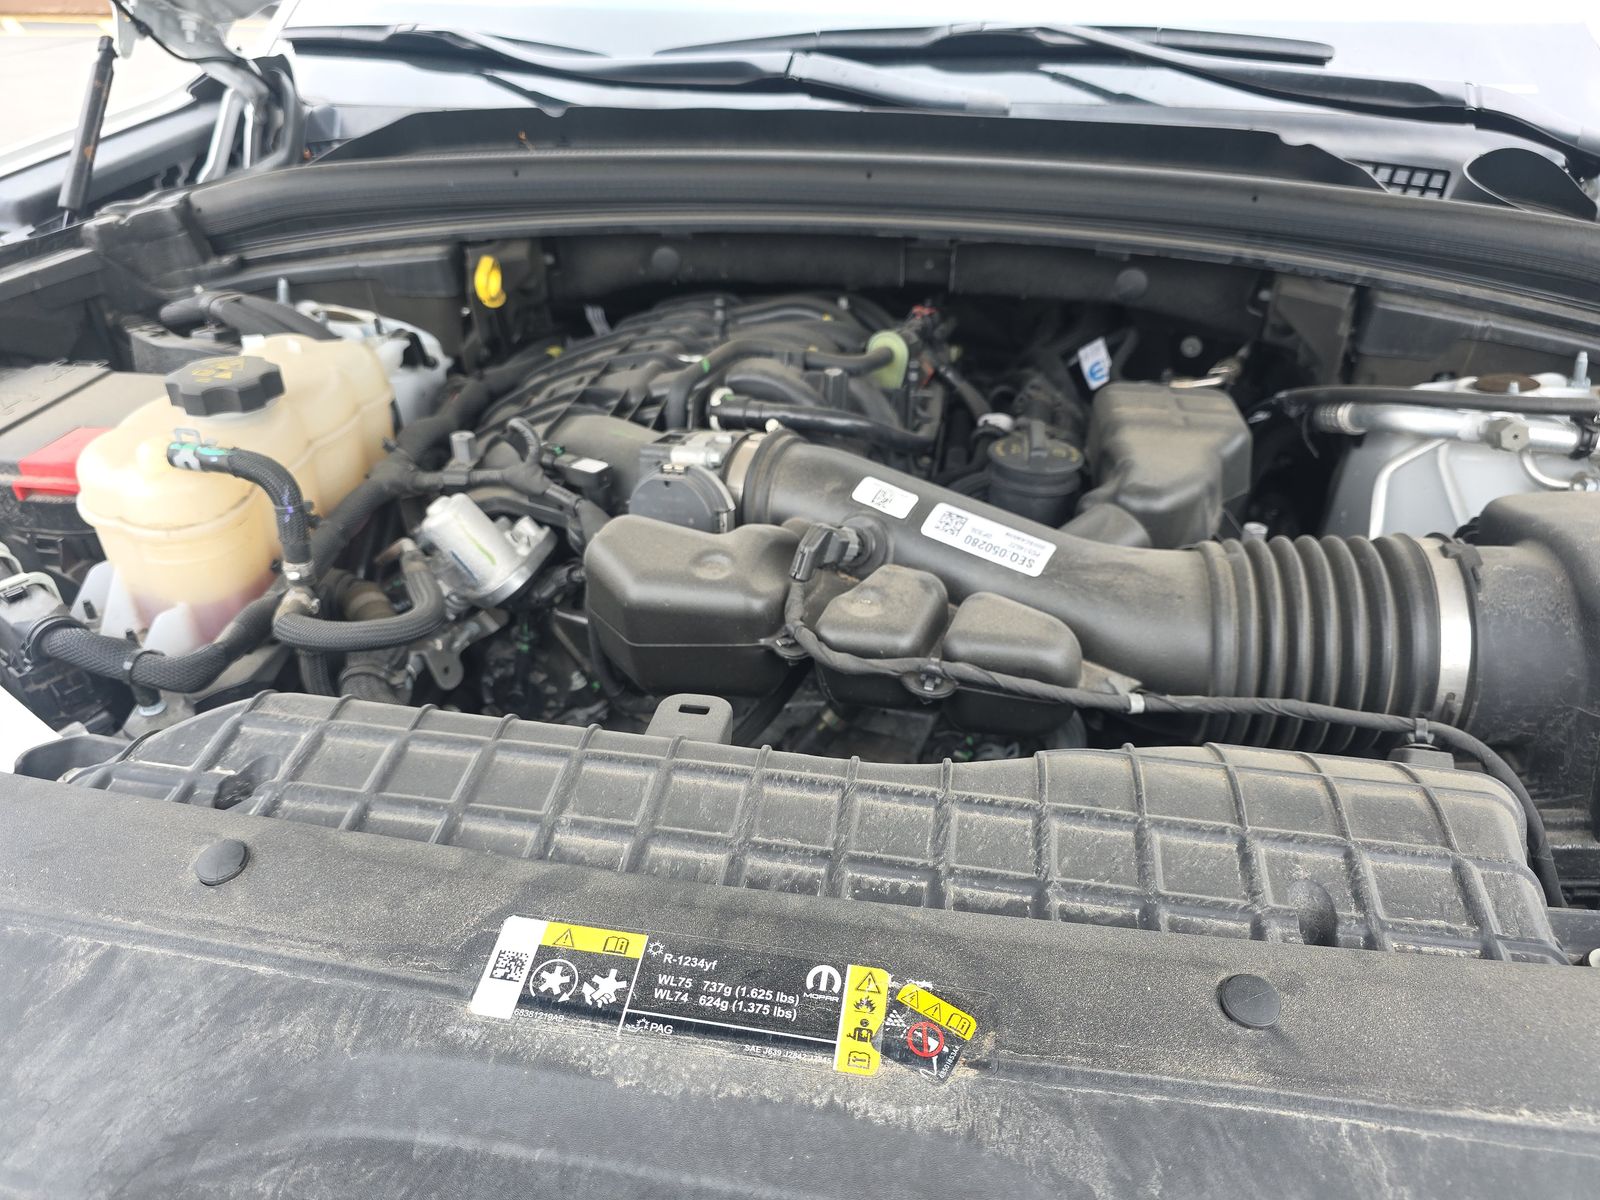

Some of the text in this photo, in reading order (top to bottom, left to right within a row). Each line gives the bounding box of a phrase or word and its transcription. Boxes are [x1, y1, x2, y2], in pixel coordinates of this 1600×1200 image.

[663, 953, 718, 971] R-1234yf
[658, 974, 800, 1006] WL75 737g (1.625 lbs)
[803, 992, 839, 1003] MOPAR
[654, 988, 797, 1021] WL74 624g (1.375 lbs)
[649, 1022, 674, 1035] PAG
[743, 1044, 762, 1053] SAE
[763, 1046, 782, 1056] J639
